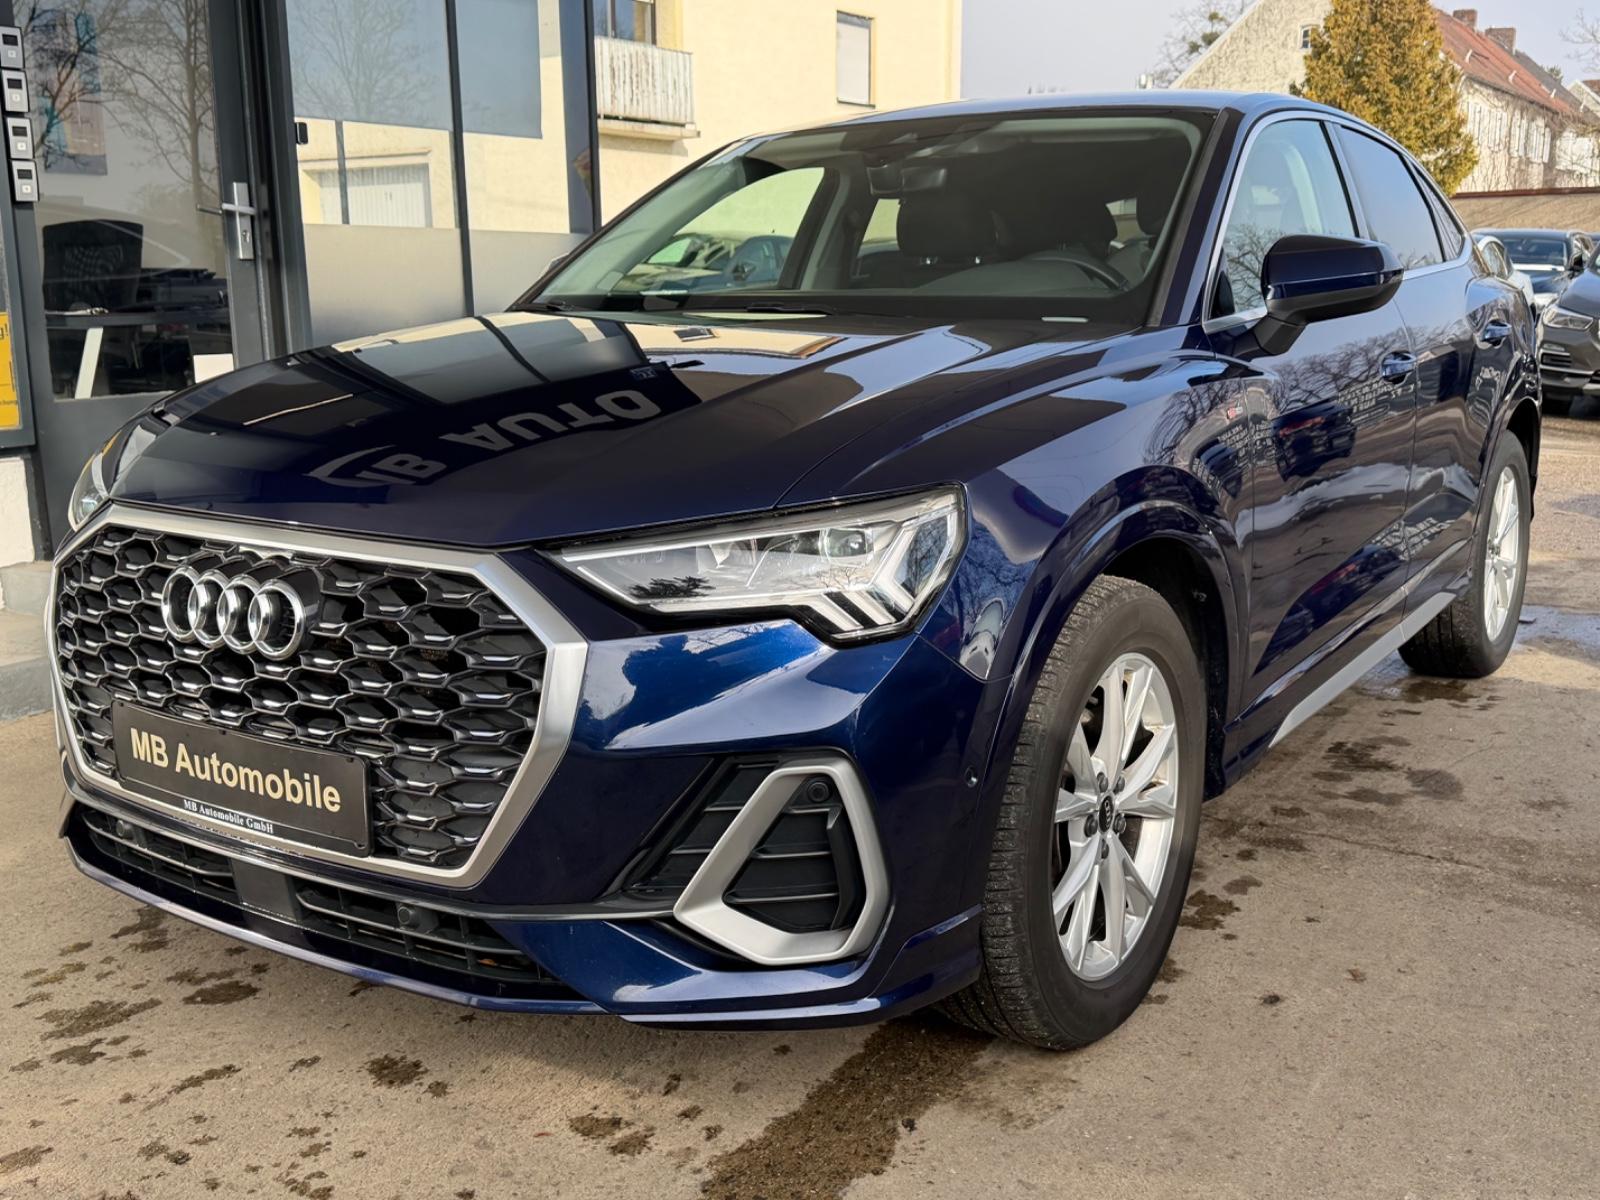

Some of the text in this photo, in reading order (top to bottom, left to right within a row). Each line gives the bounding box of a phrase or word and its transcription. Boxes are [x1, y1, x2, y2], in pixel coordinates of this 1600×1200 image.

[130, 727, 342, 813] MB Automobile
[183, 799, 275, 834] MB Automobile GmbH
